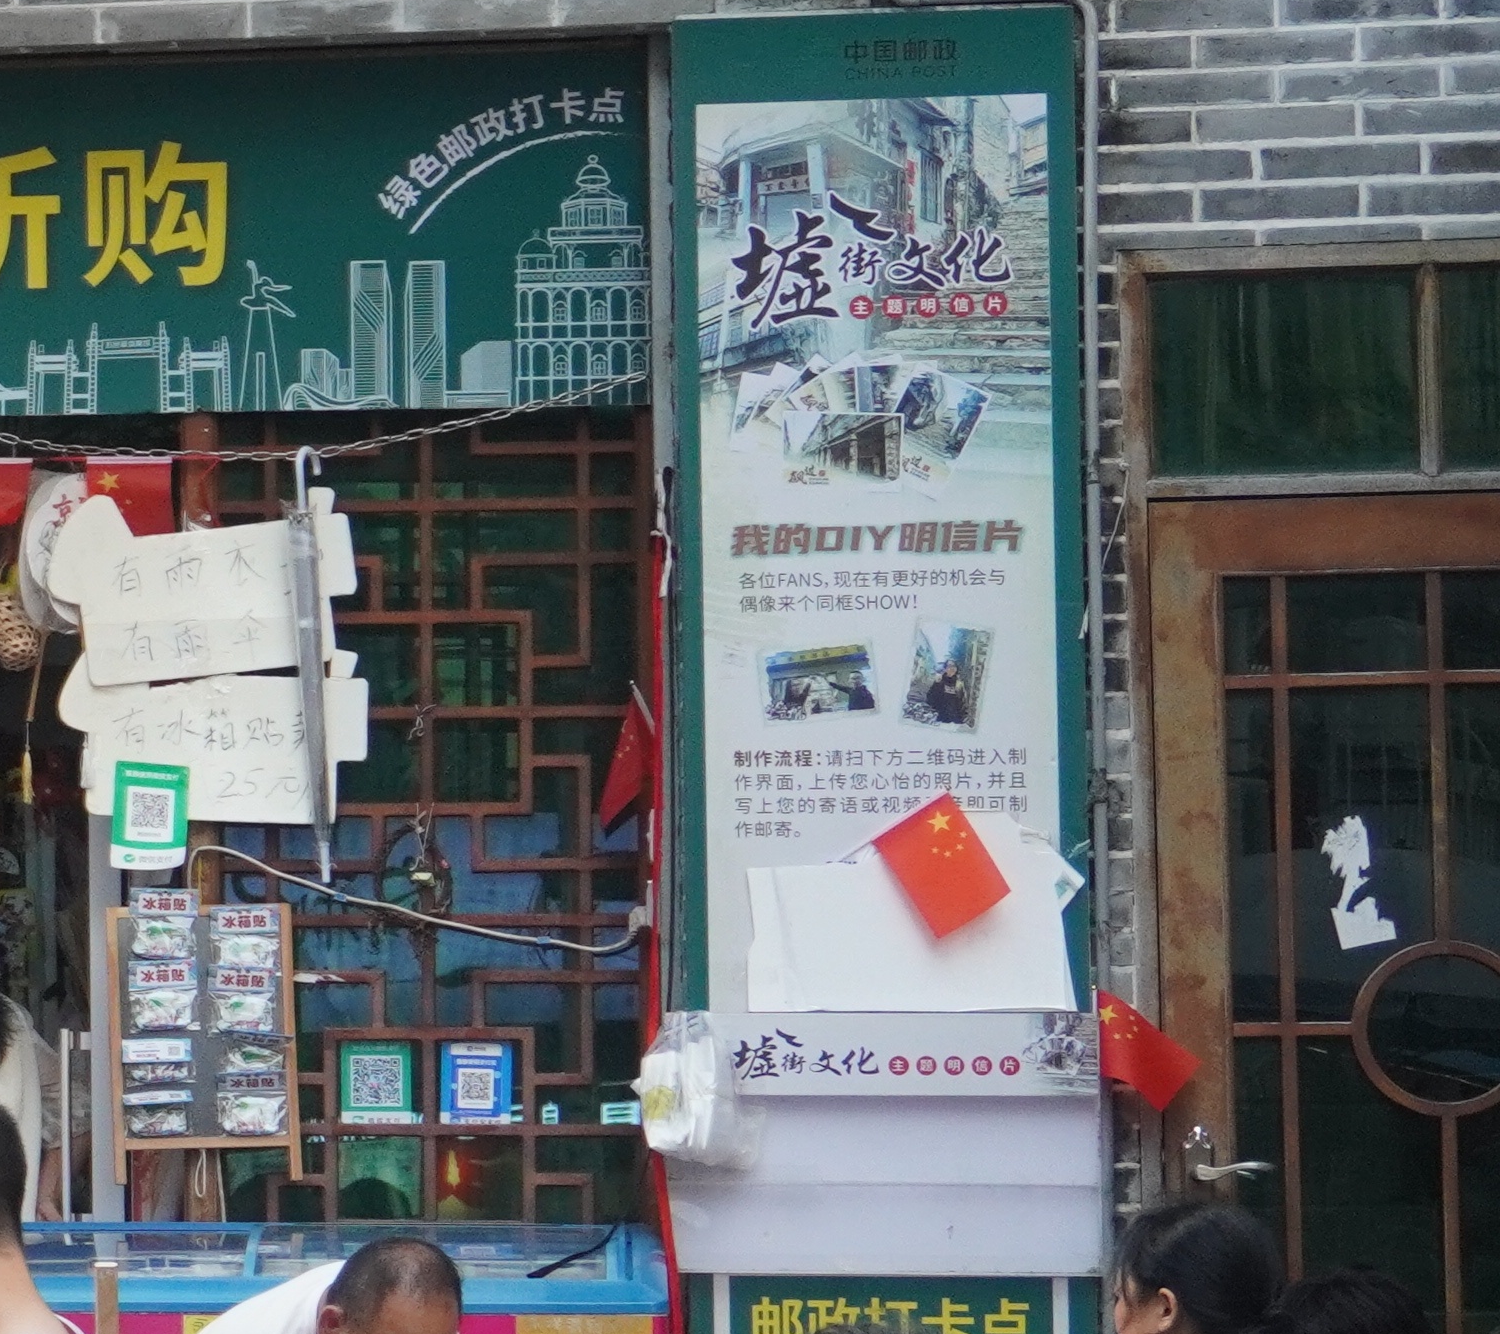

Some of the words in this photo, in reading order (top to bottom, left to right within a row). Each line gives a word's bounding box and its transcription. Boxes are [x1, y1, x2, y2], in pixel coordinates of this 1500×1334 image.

[844, 39, 959, 63] 中国邮政
[377, 87, 626, 220] 绿色邮政打卡点
[851, 294, 1007, 318] 主题明信片
[731, 520, 1024, 556] 我的DIY明信片
[143, 897, 187, 911] 冰箱贴
[222, 915, 267, 929] 冰箱贴
[141, 969, 185, 983] 冰箱贴
[221, 973, 265, 988] 冰箱贴
[889, 1056, 1021, 1076] 主题明信片
[231, 1078, 275, 1088] 冰箱贴
